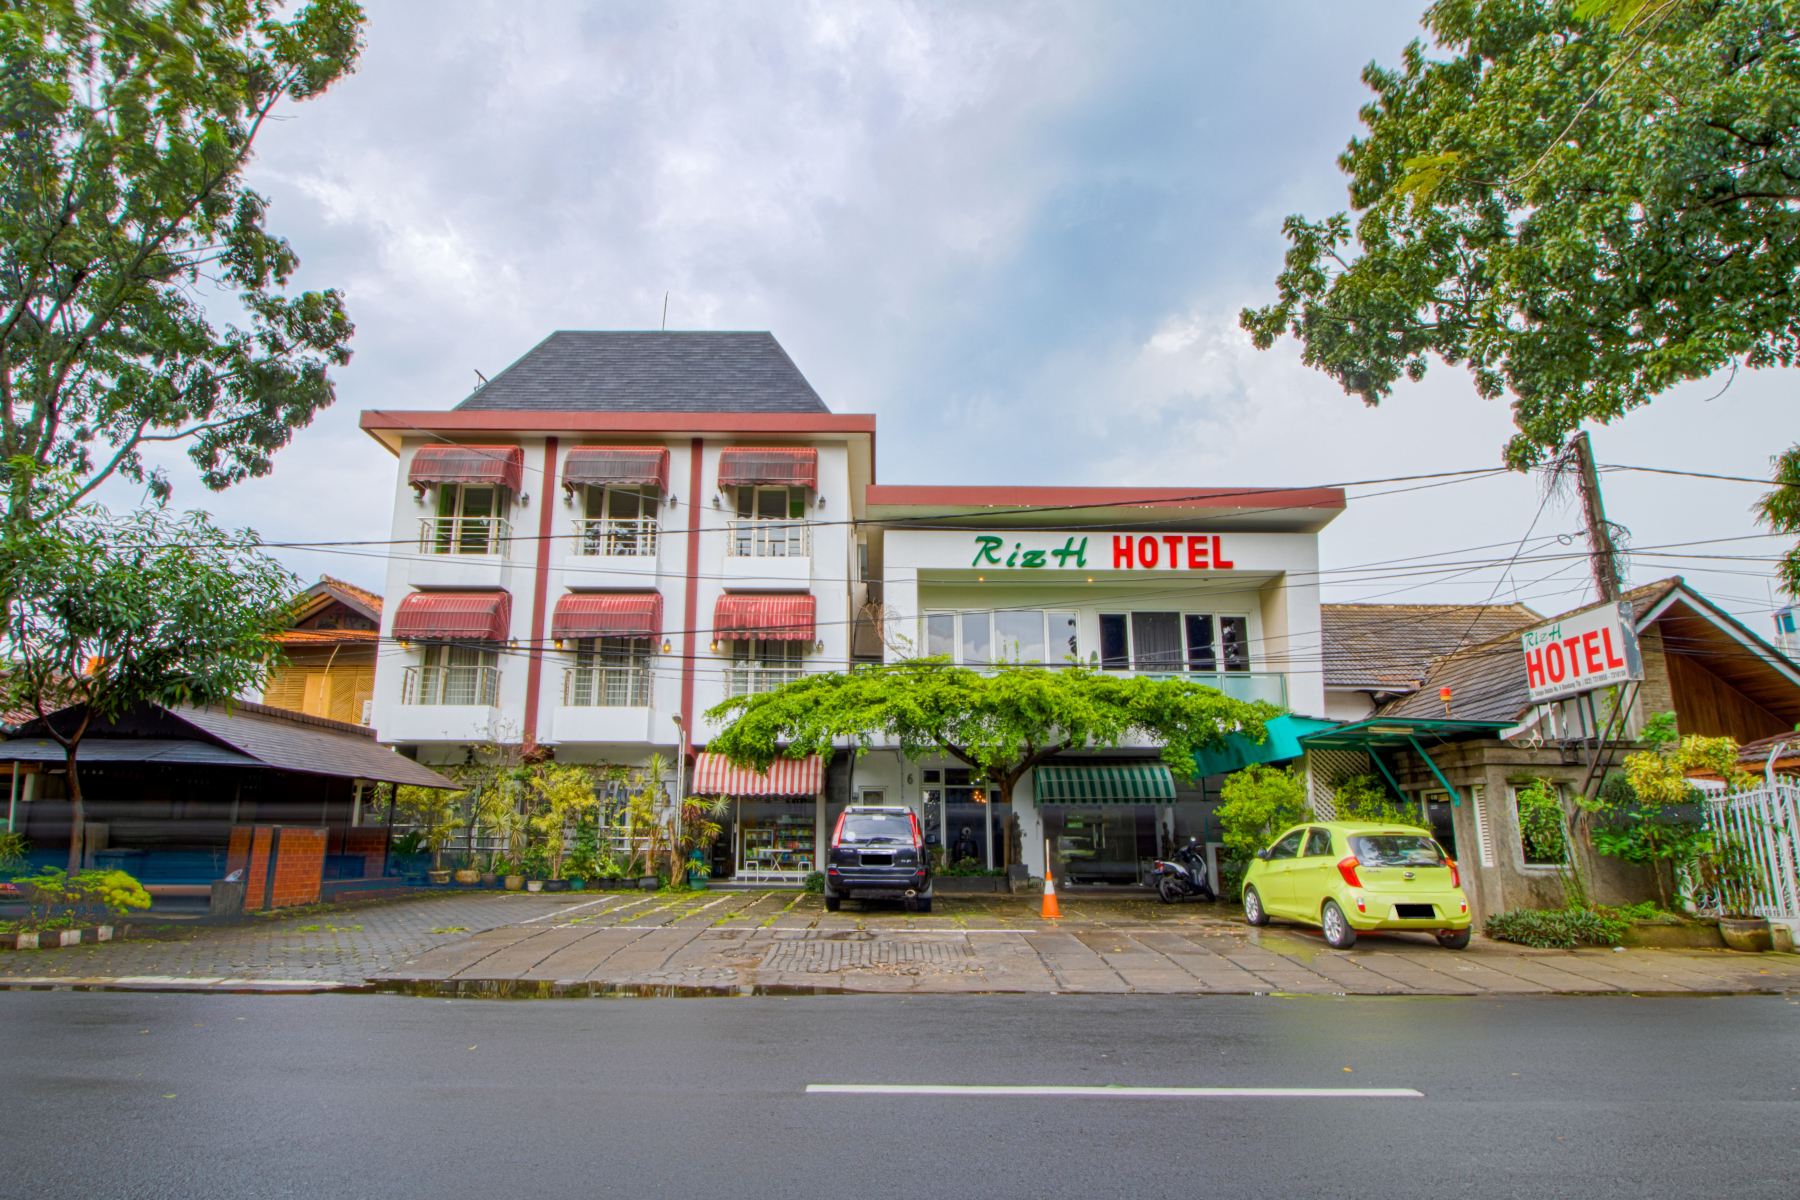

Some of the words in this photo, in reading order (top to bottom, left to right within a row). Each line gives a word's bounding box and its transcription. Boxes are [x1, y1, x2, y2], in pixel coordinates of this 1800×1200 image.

[972, 535, 1088, 568] RizH
[1113, 535, 1234, 569] HOTEL
[1525, 623, 1562, 648] RizH
[1526, 628, 1623, 688] HOTEL
[907, 773, 914, 784] 6
